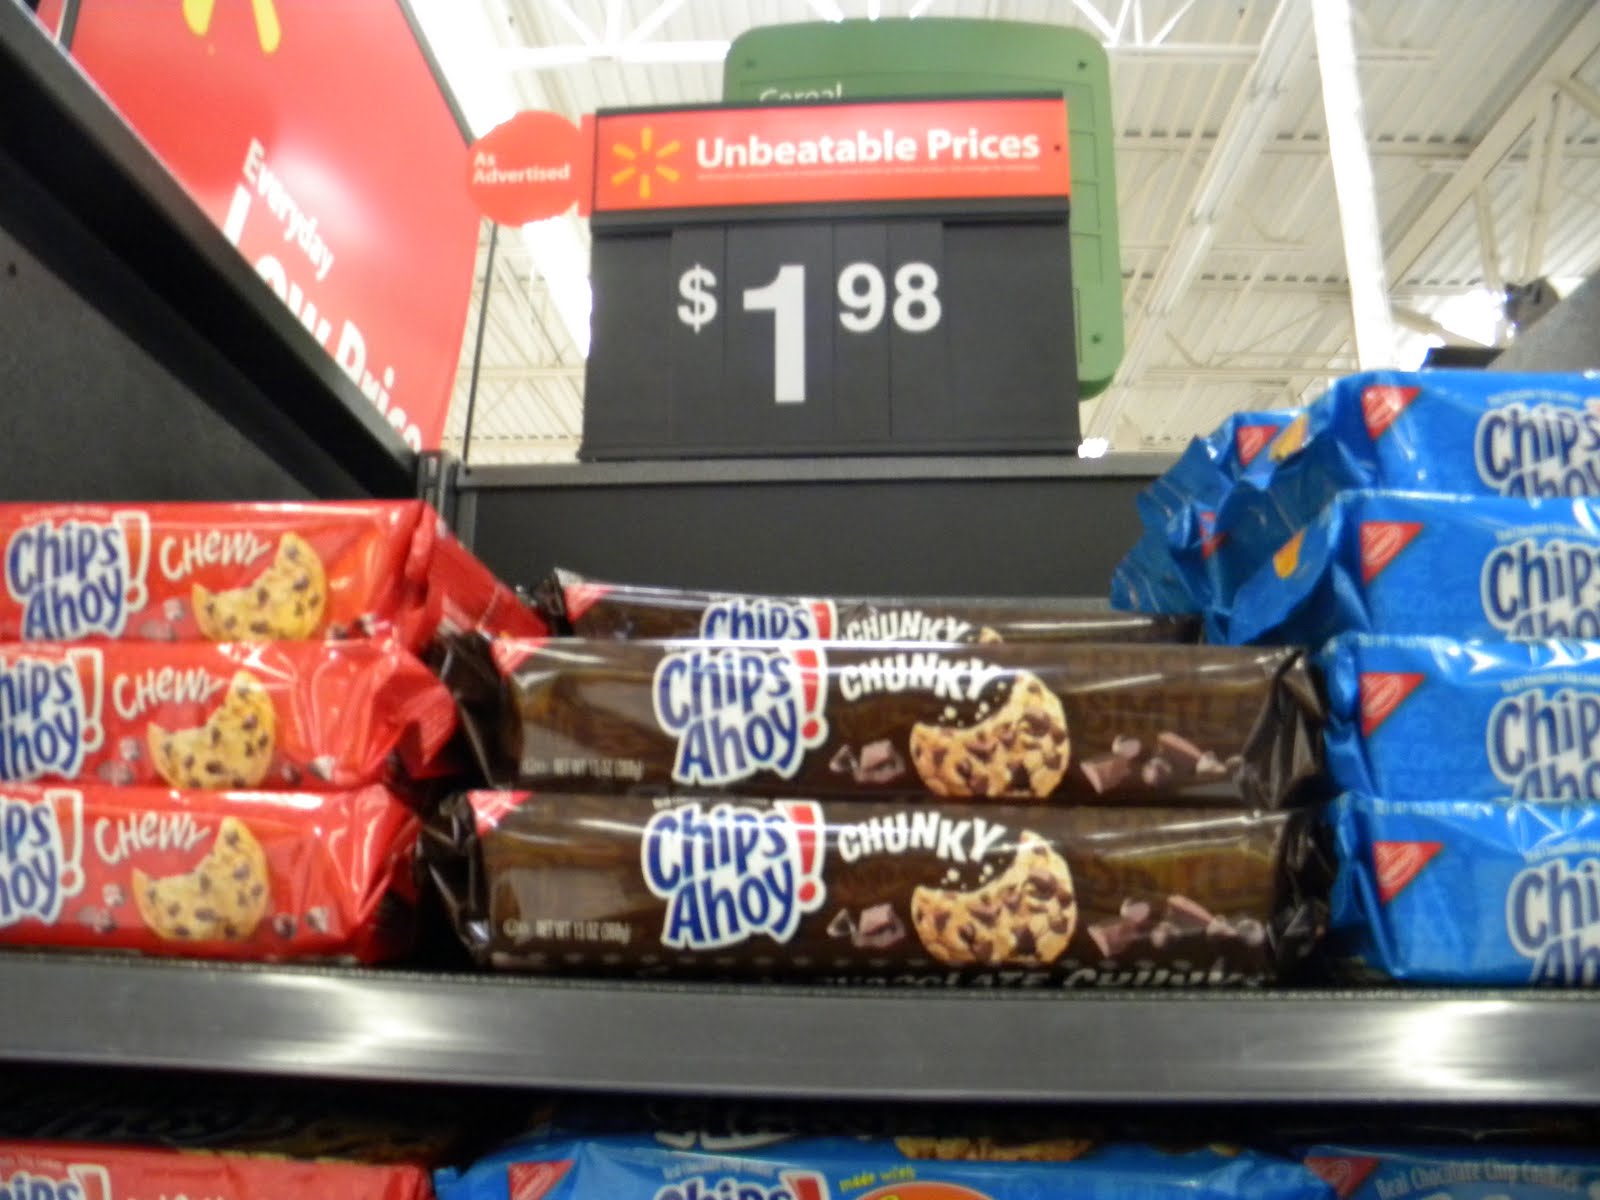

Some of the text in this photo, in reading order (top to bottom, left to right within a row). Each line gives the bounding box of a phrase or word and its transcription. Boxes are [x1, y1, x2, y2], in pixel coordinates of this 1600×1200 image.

[472, 161, 571, 184] Advertised
[474, 151, 496, 167] As
[696, 128, 1041, 169] Unbeatable Prices
[242, 137, 335, 281] Everyday
[6, 521, 121, 598] Chips
[1487, 542, 1600, 623] Chip
[657, 652, 793, 731] Chips
[839, 652, 1002, 702] CHUNKY
[1494, 691, 1600, 778] Chip
[646, 808, 789, 892] Chips
[838, 810, 1008, 864] CHUNKY
[1513, 861, 1600, 952] Chi
